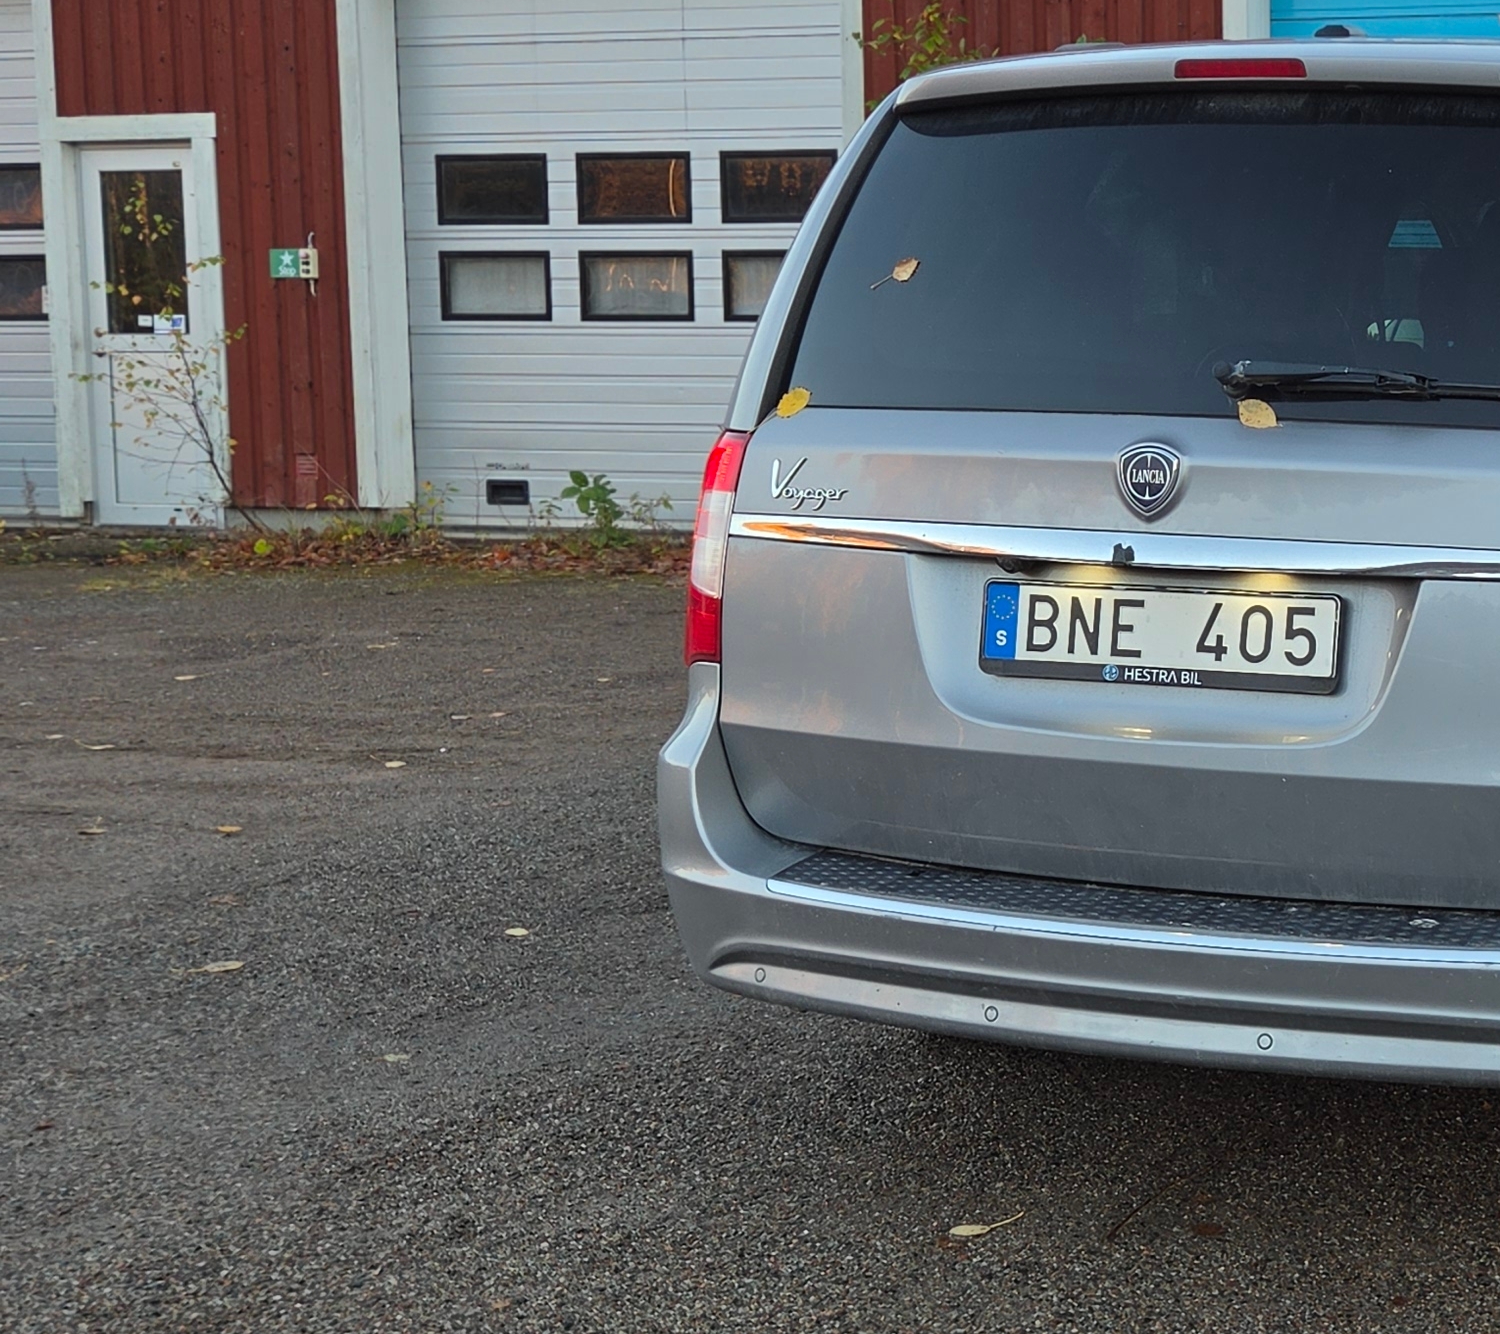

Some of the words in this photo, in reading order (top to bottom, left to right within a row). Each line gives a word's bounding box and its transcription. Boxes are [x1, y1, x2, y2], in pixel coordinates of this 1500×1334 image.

[771, 456, 849, 511] Voyager
[1132, 468, 1165, 484] LANCIA
[996, 630, 1007, 646] S
[1026, 594, 1145, 658] BNE
[1196, 602, 1317, 666] 405
[1124, 667, 1178, 684] HESTRA
[1181, 671, 1202, 685] BIL
